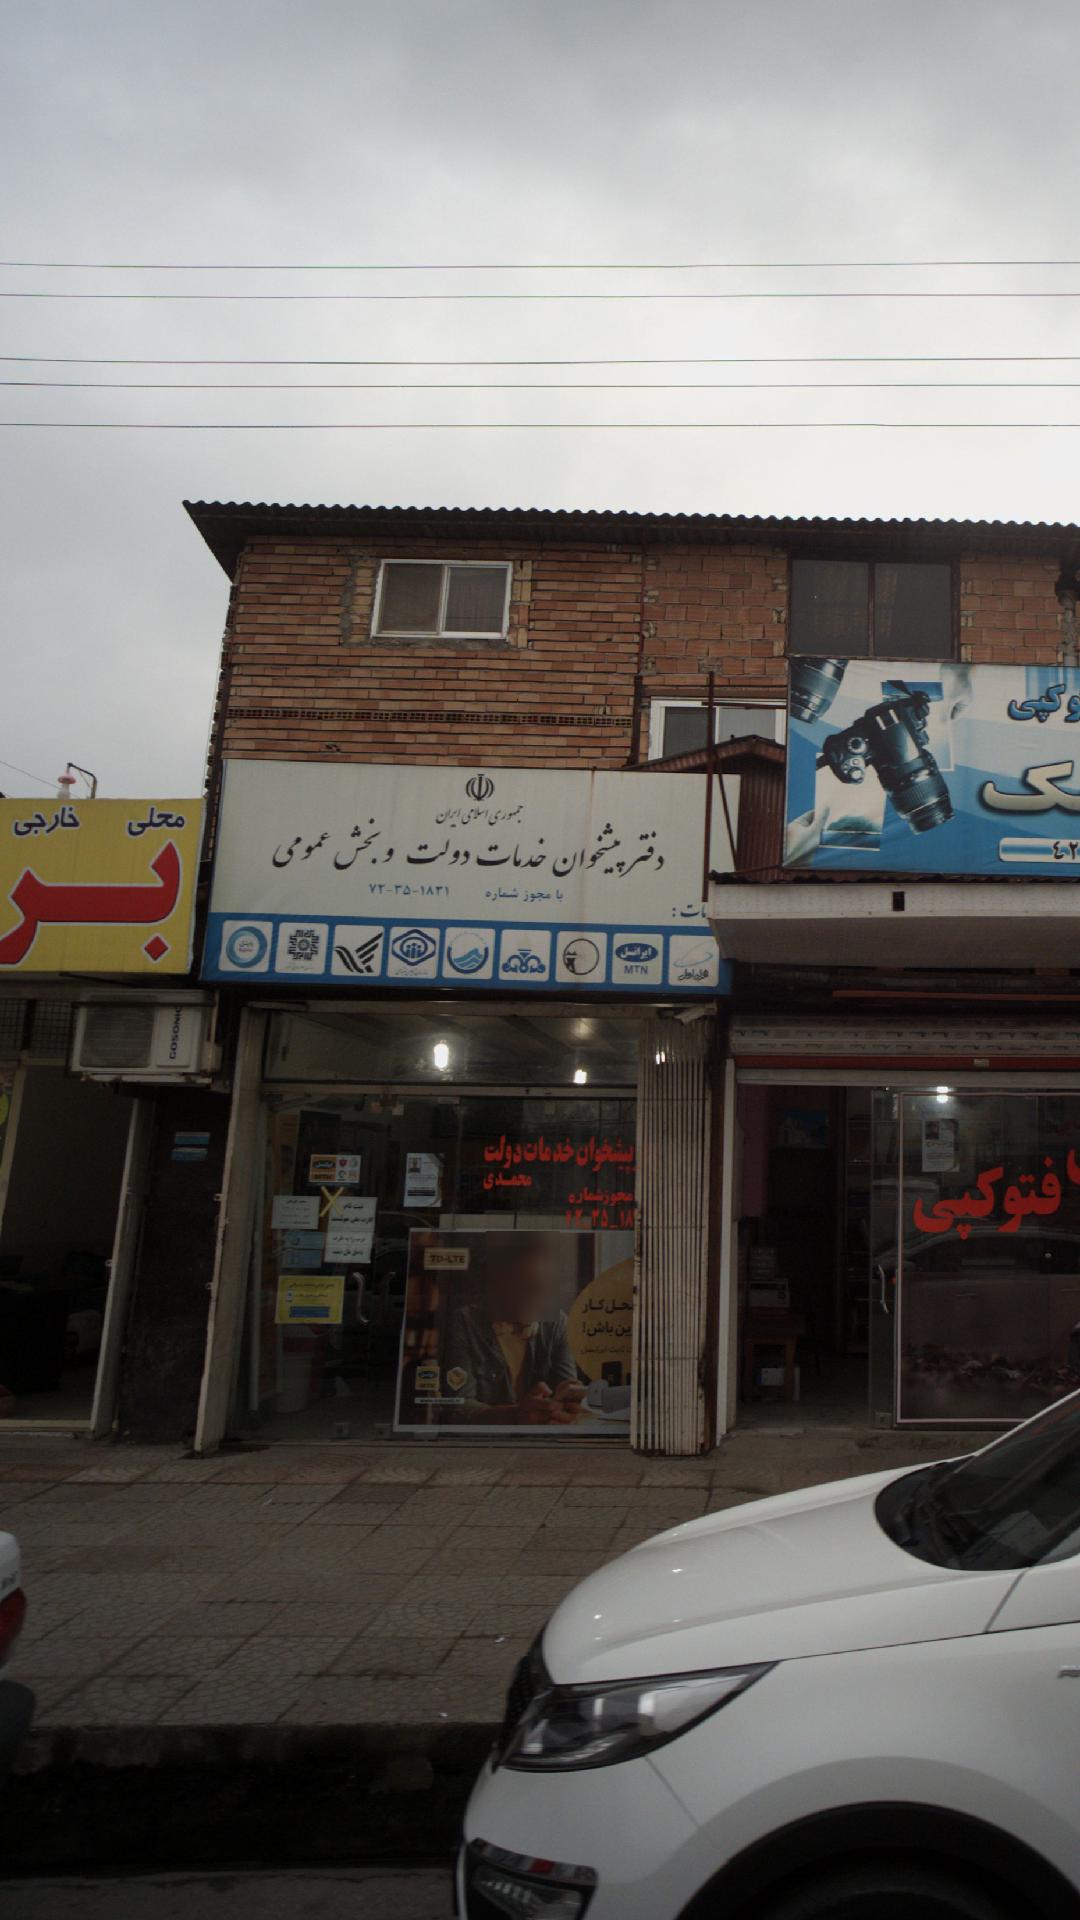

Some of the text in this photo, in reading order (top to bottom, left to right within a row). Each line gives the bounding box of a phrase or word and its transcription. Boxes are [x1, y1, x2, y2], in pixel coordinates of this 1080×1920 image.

[1007, 683, 1080, 723] وکپی
[14, 806, 185, 836] محلی خارجی
[435, 805, 524, 828] جمهوری اسلامی ایران
[271, 817, 665, 878] دفتر پیشخوان خدمات دولت و بخش عمومی
[0, 841, 181, 966] بر
[485, 887, 519, 901] شماره
[523, 890, 551, 902] مجوز
[555, 889, 564, 900] با
[620, 946, 653, 960] ایرانسل
[624, 964, 648, 975] MTN
[484, 1135, 522, 1169] دولت
[523, 1135, 574, 1164] خدمات
[483, 1171, 533, 1190] محمدی
[913, 1156, 1062, 1240] فتوکپی
[431, 1255, 465, 1264] TD-LTE
